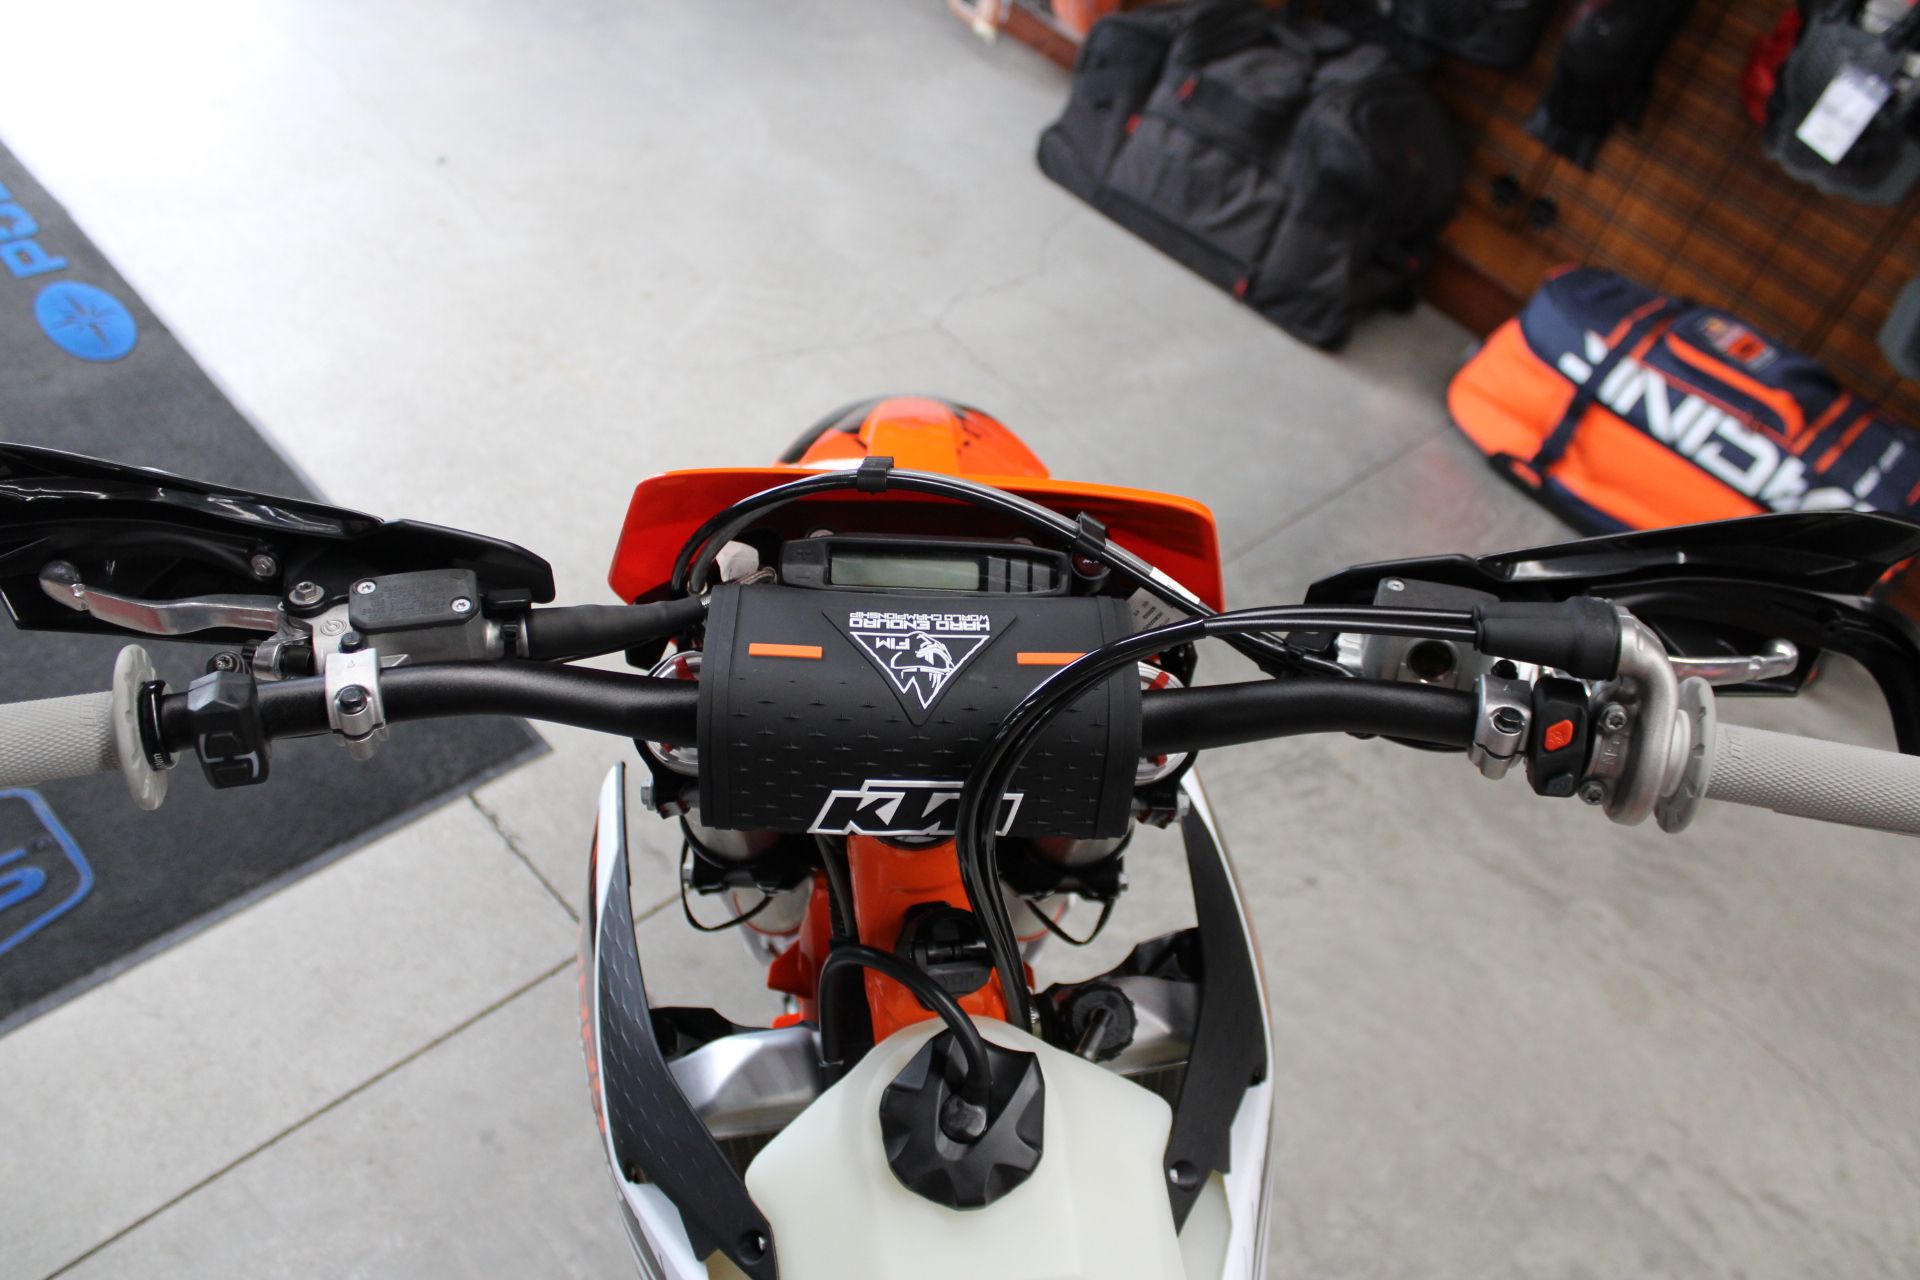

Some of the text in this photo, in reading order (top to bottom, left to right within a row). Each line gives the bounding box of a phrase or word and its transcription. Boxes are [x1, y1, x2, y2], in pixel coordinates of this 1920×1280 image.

[849, 611, 989, 622] WORLD CHAMPIONSHIP
[849, 617, 990, 631] HARD ENDURO
[875, 637, 910, 650] FIM
